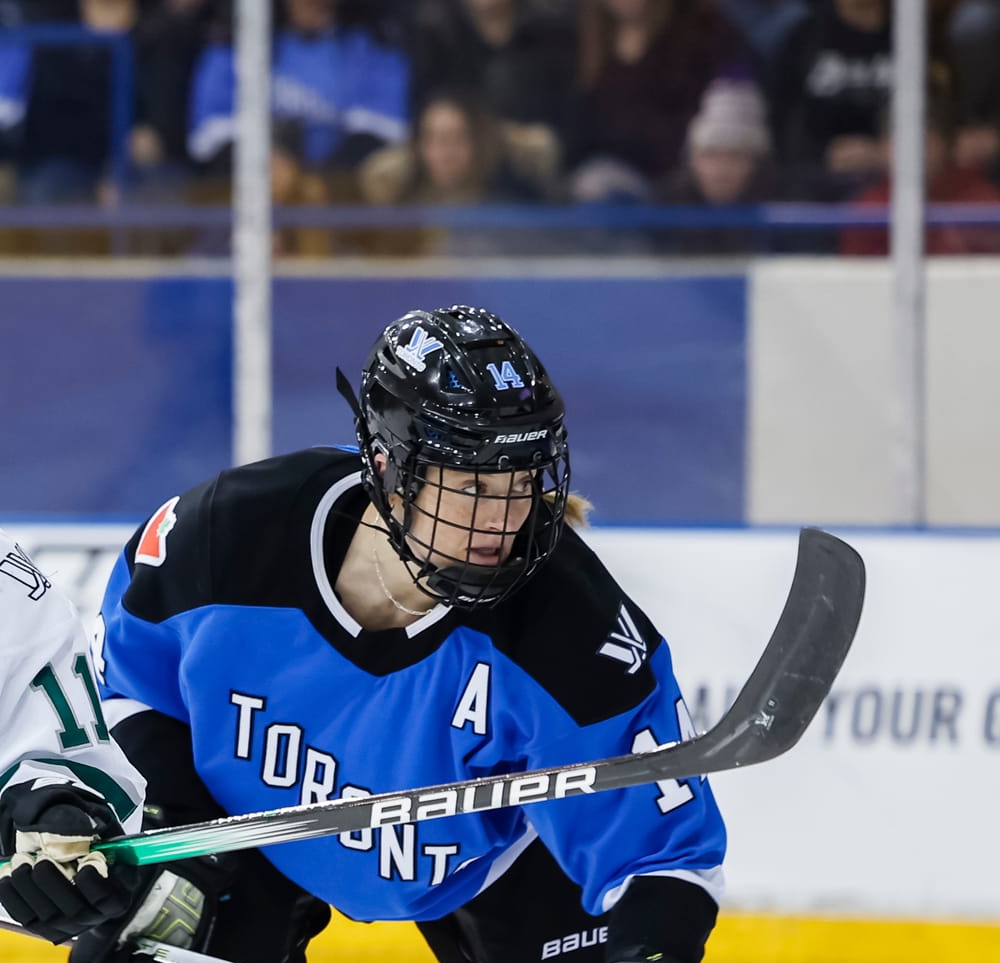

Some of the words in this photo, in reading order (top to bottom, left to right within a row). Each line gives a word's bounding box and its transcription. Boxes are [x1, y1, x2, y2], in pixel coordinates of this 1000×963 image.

[486, 361, 524, 391] 14
[494, 429, 549, 444] BAUER
[31, 652, 110, 752] 11
[451, 662, 491, 735] A
[824, 684, 963, 747] YOUR
[230, 691, 482, 886] TORONT
[370, 766, 599, 829] BAUER
[541, 926, 609, 961] BAUE
